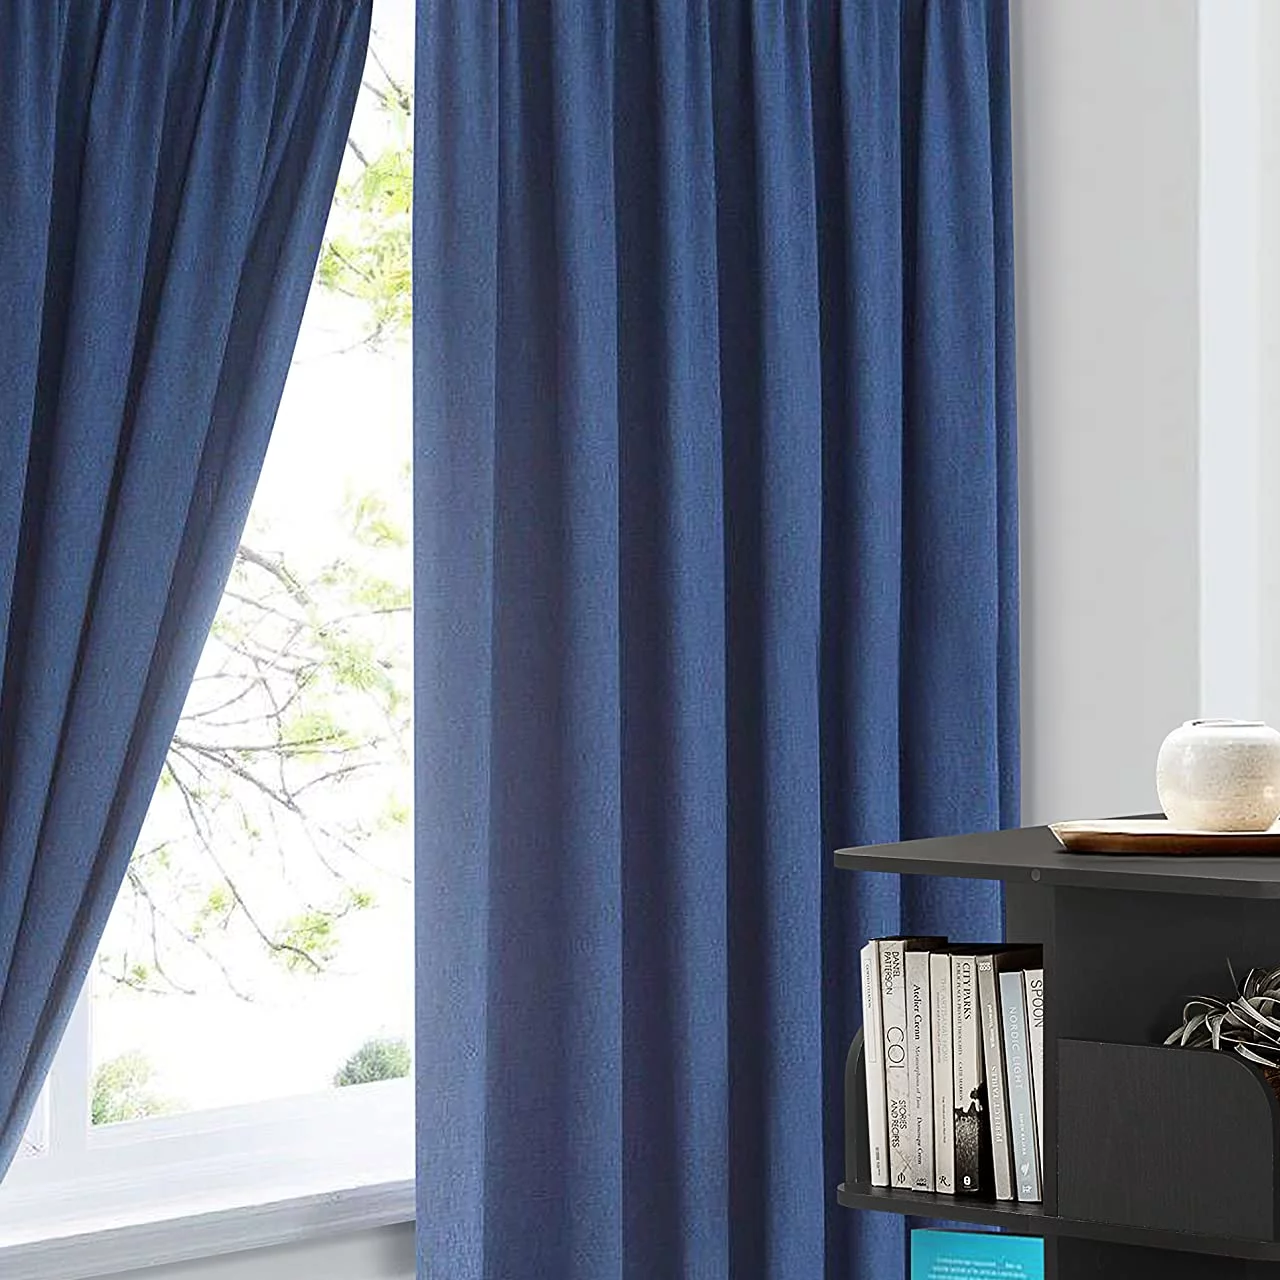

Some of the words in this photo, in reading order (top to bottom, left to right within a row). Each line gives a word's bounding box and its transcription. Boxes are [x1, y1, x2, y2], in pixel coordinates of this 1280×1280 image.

[884, 952, 894, 995] PATTERSON
[892, 952, 901, 977] DANIEL
[962, 962, 971, 986] CITY
[912, 984, 922, 1013] Atelier
[963, 987, 972, 1020] PARKS
[1030, 980, 1043, 1028] SPOON
[913, 1014, 923, 1040] Crenn
[1008, 1006, 1021, 1053] NORDIC
[886, 1027, 905, 1069] COI
[1010, 1056, 1023, 1089] LIGHT
[891, 1100, 899, 1118] AND
[898, 1100, 907, 1129] STORIES
[891, 1119, 901, 1148] RECIPES
